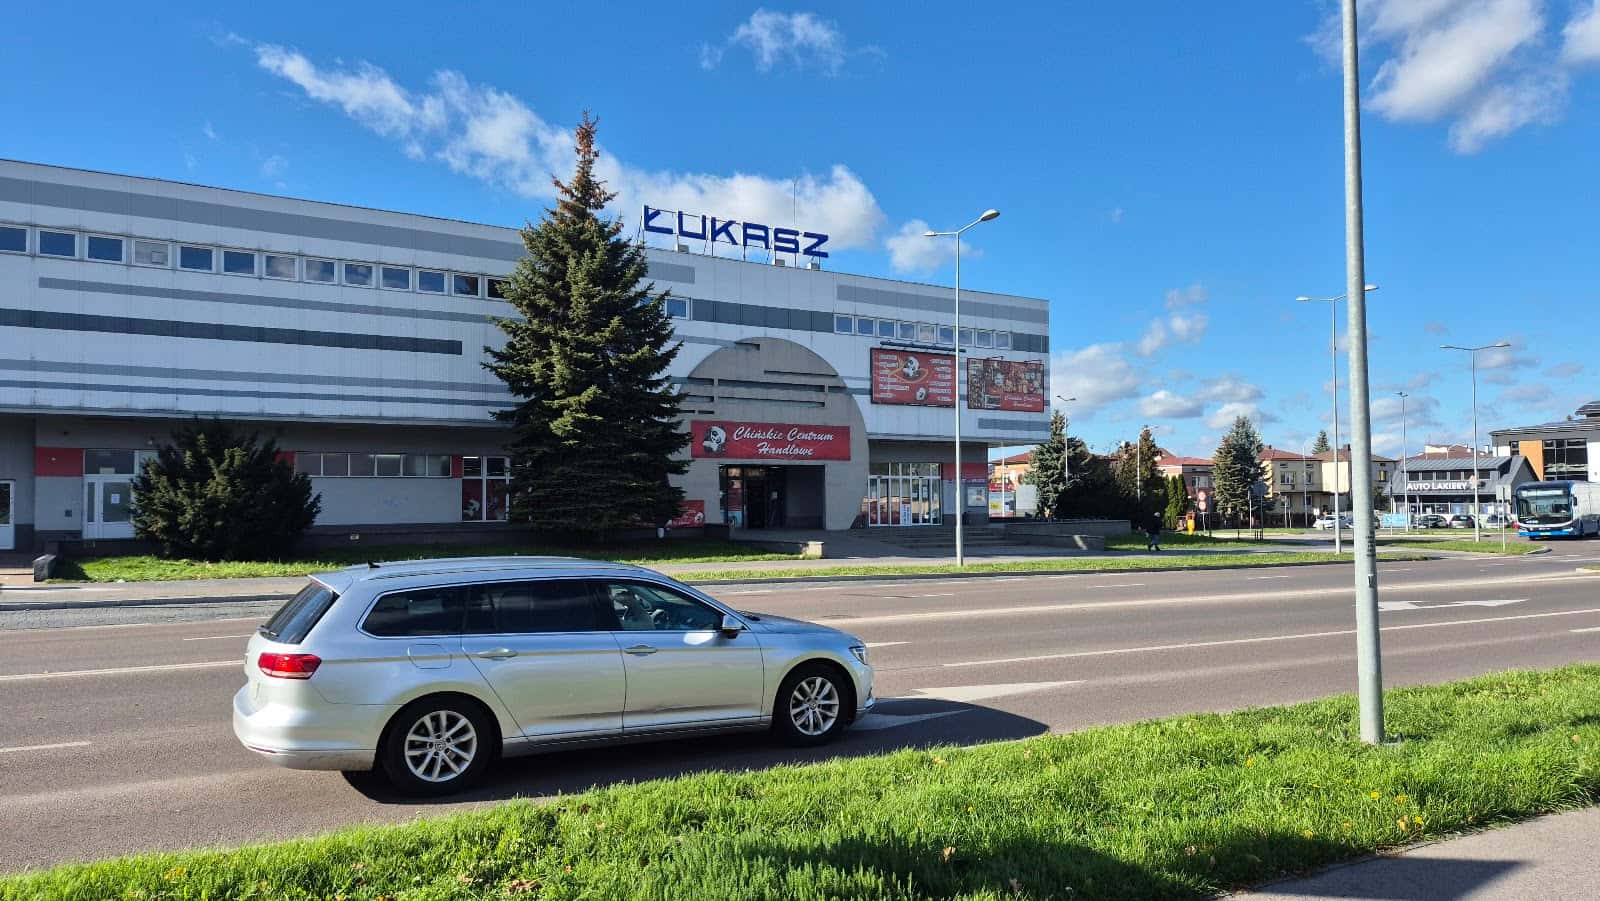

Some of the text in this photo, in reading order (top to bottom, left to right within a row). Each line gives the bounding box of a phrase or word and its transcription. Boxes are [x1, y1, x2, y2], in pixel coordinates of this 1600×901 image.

[643, 204, 829, 258] ŁUKASZ
[734, 425, 834, 441] Chińskie Centrum
[757, 442, 814, 456] Handlowe
[1407, 482, 1430, 490] AUTO
